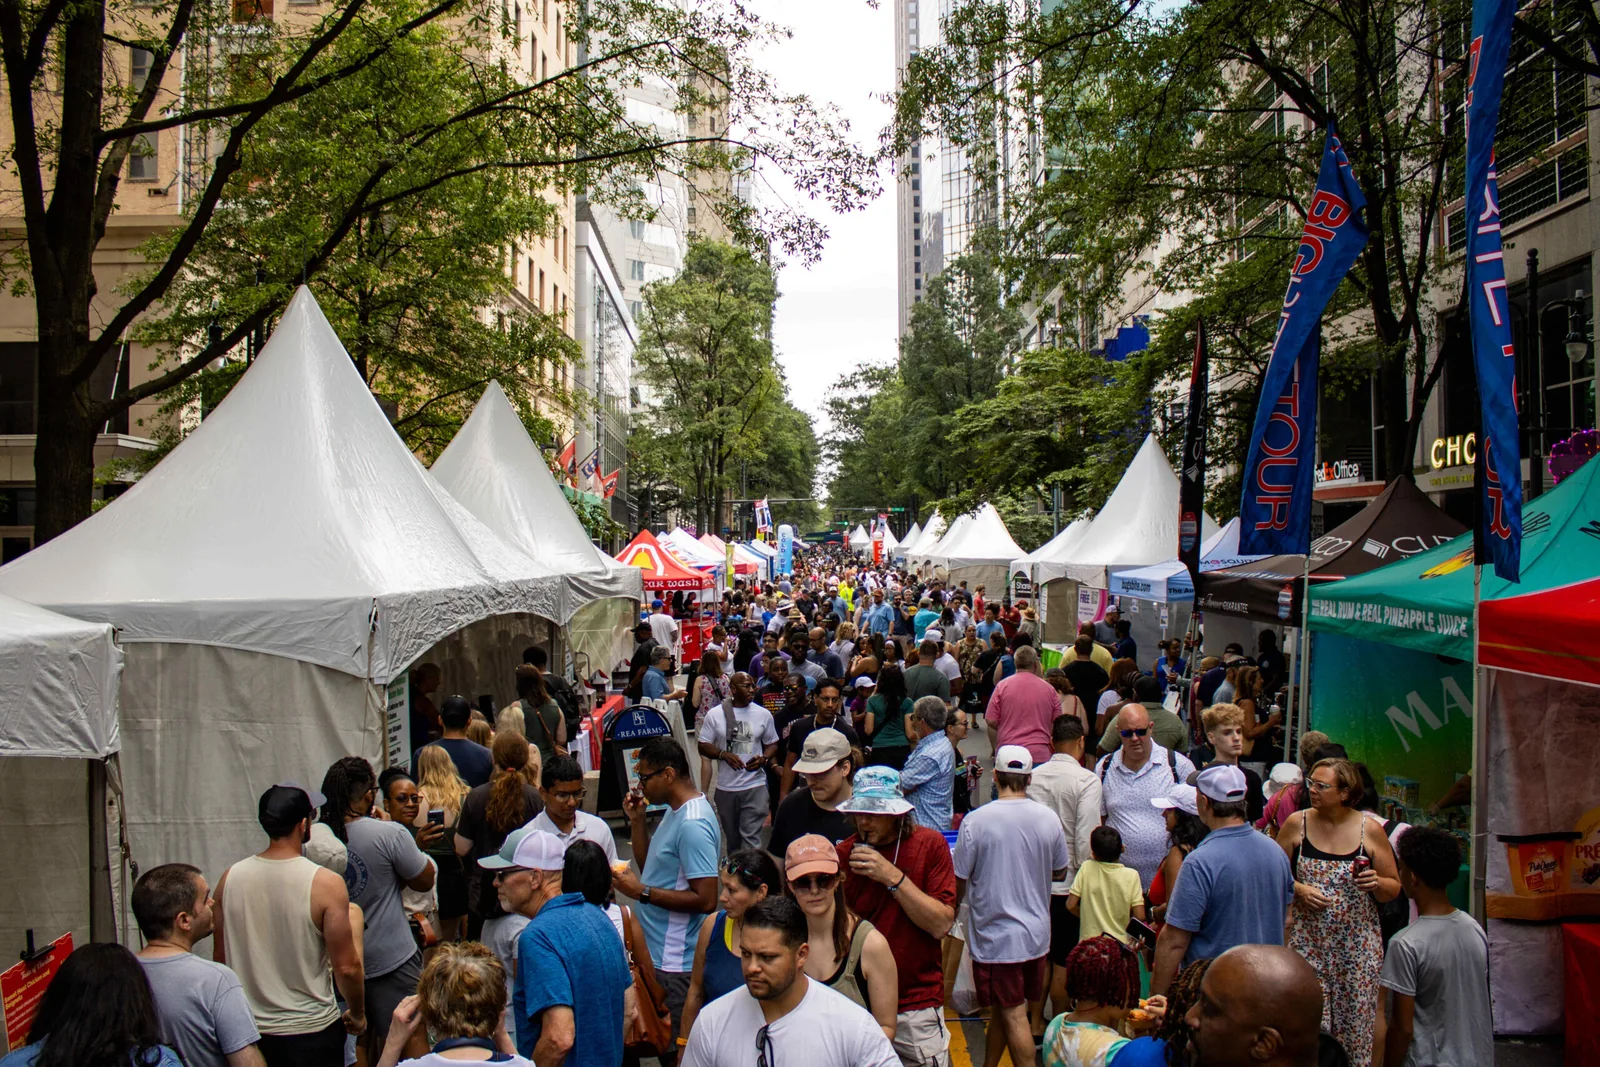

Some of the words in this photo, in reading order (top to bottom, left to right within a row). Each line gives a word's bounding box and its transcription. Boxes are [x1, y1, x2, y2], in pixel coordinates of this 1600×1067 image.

[1291, 189, 1353, 276] BIG
[1255, 382, 1301, 531] TOUR
[1334, 459, 1360, 480] Office
[1320, 600, 1337, 618] REAL
[1338, 601, 1355, 620] RUM
[1355, 603, 1361, 621] &
[1362, 603, 1383, 624] REAL
[1383, 605, 1436, 633] PINEAPPLE
[1437, 612, 1469, 638] JUICE
[620, 729, 637, 739] REA
[637, 727, 664, 738] FARMS
